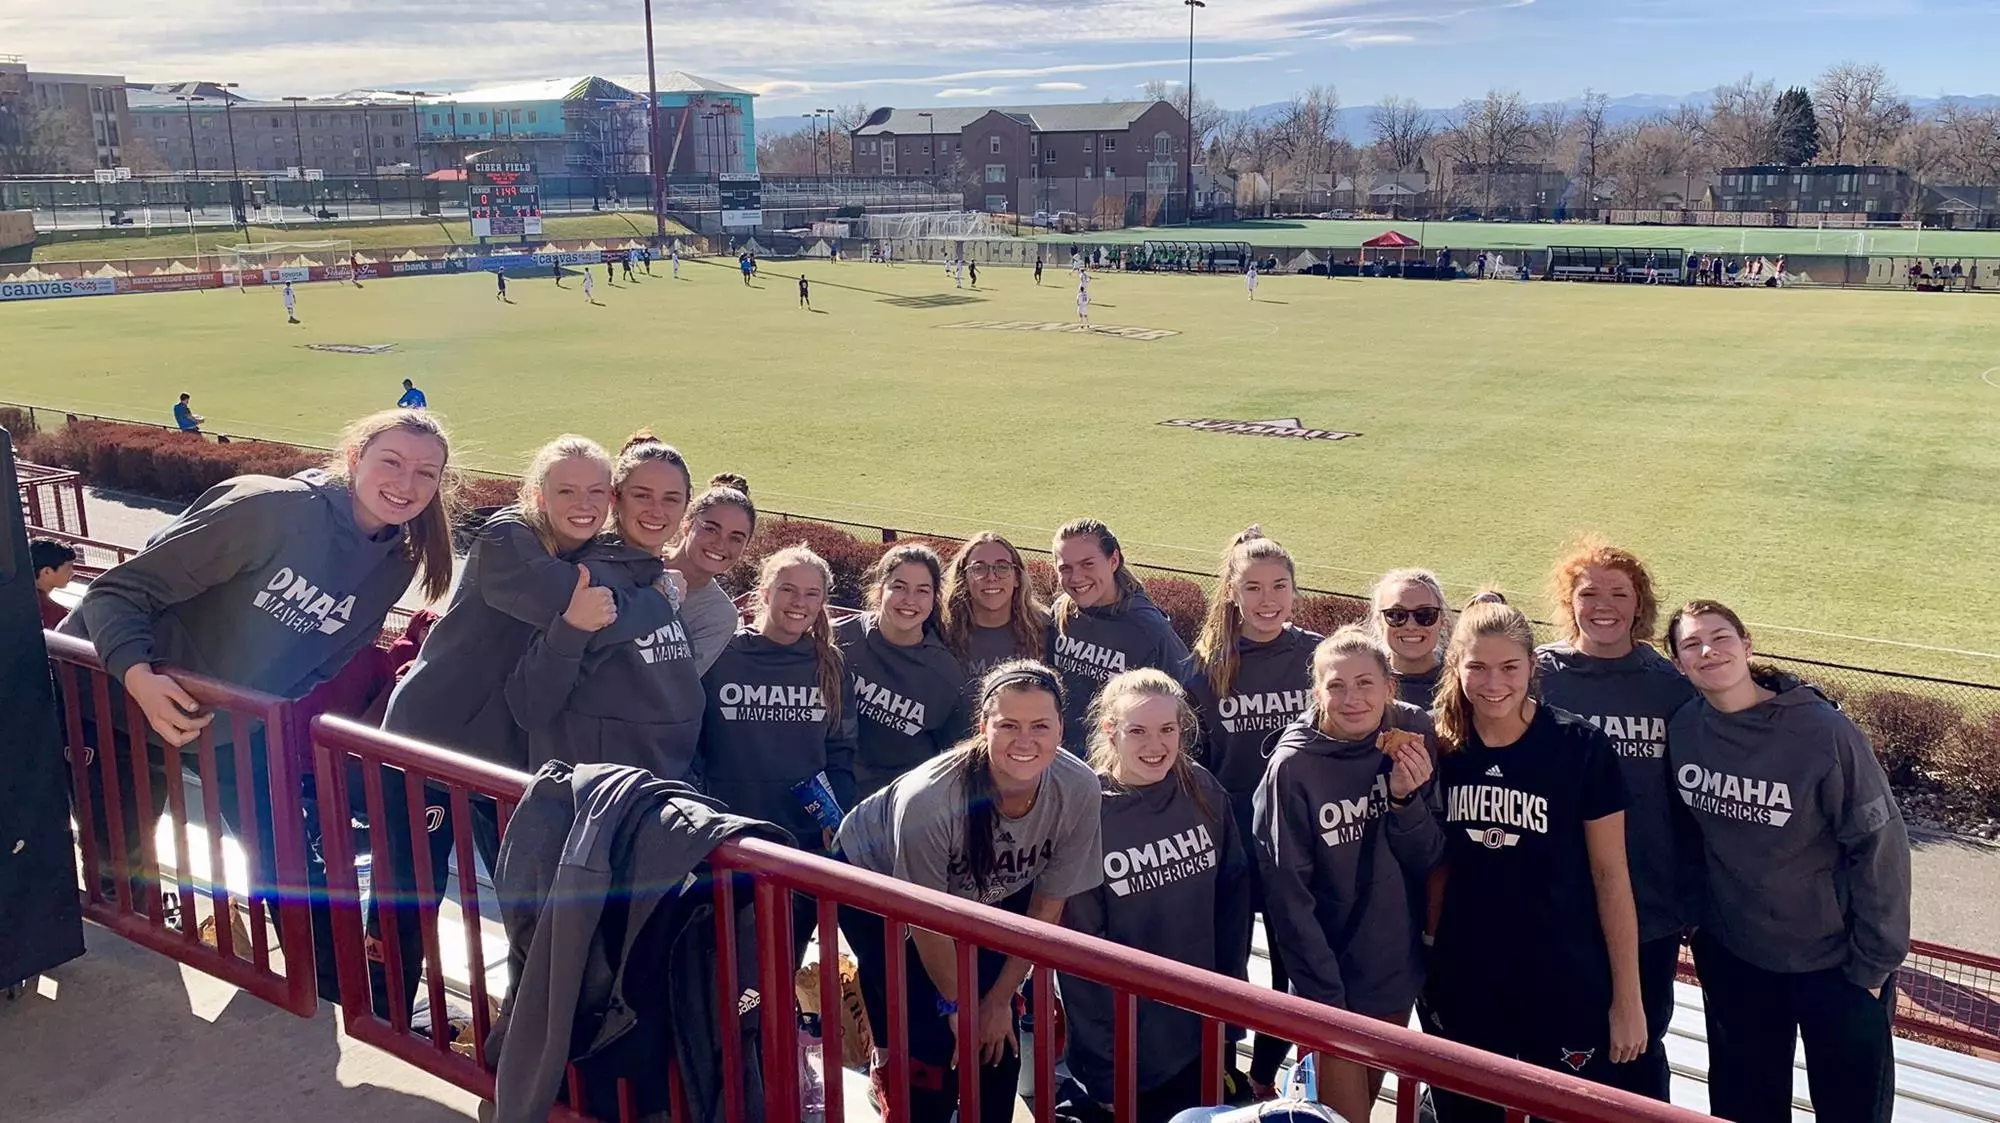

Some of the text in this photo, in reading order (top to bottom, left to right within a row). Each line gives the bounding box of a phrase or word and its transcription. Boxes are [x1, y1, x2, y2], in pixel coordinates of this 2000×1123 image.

[475, 163, 531, 172] CIBER FIELD
[963, 239, 1037, 264] SOCCER
[2, 282, 73, 297] canvas
[1155, 418, 1362, 441] SUMMIT
[1055, 634, 1126, 673] OMAHA
[719, 682, 827, 707] OMAHA
[851, 672, 925, 726] MAHA
[736, 707, 813, 721] MAVERICKS
[856, 699, 908, 733] VERICKS
[1678, 763, 1794, 811] OMAHA
[1446, 785, 1548, 834] MAVERICKS
[1691, 793, 1772, 825] MAVERICKS
[1103, 823, 1214, 879] OMAHA
[1129, 854, 1210, 894] MAVERICKS
